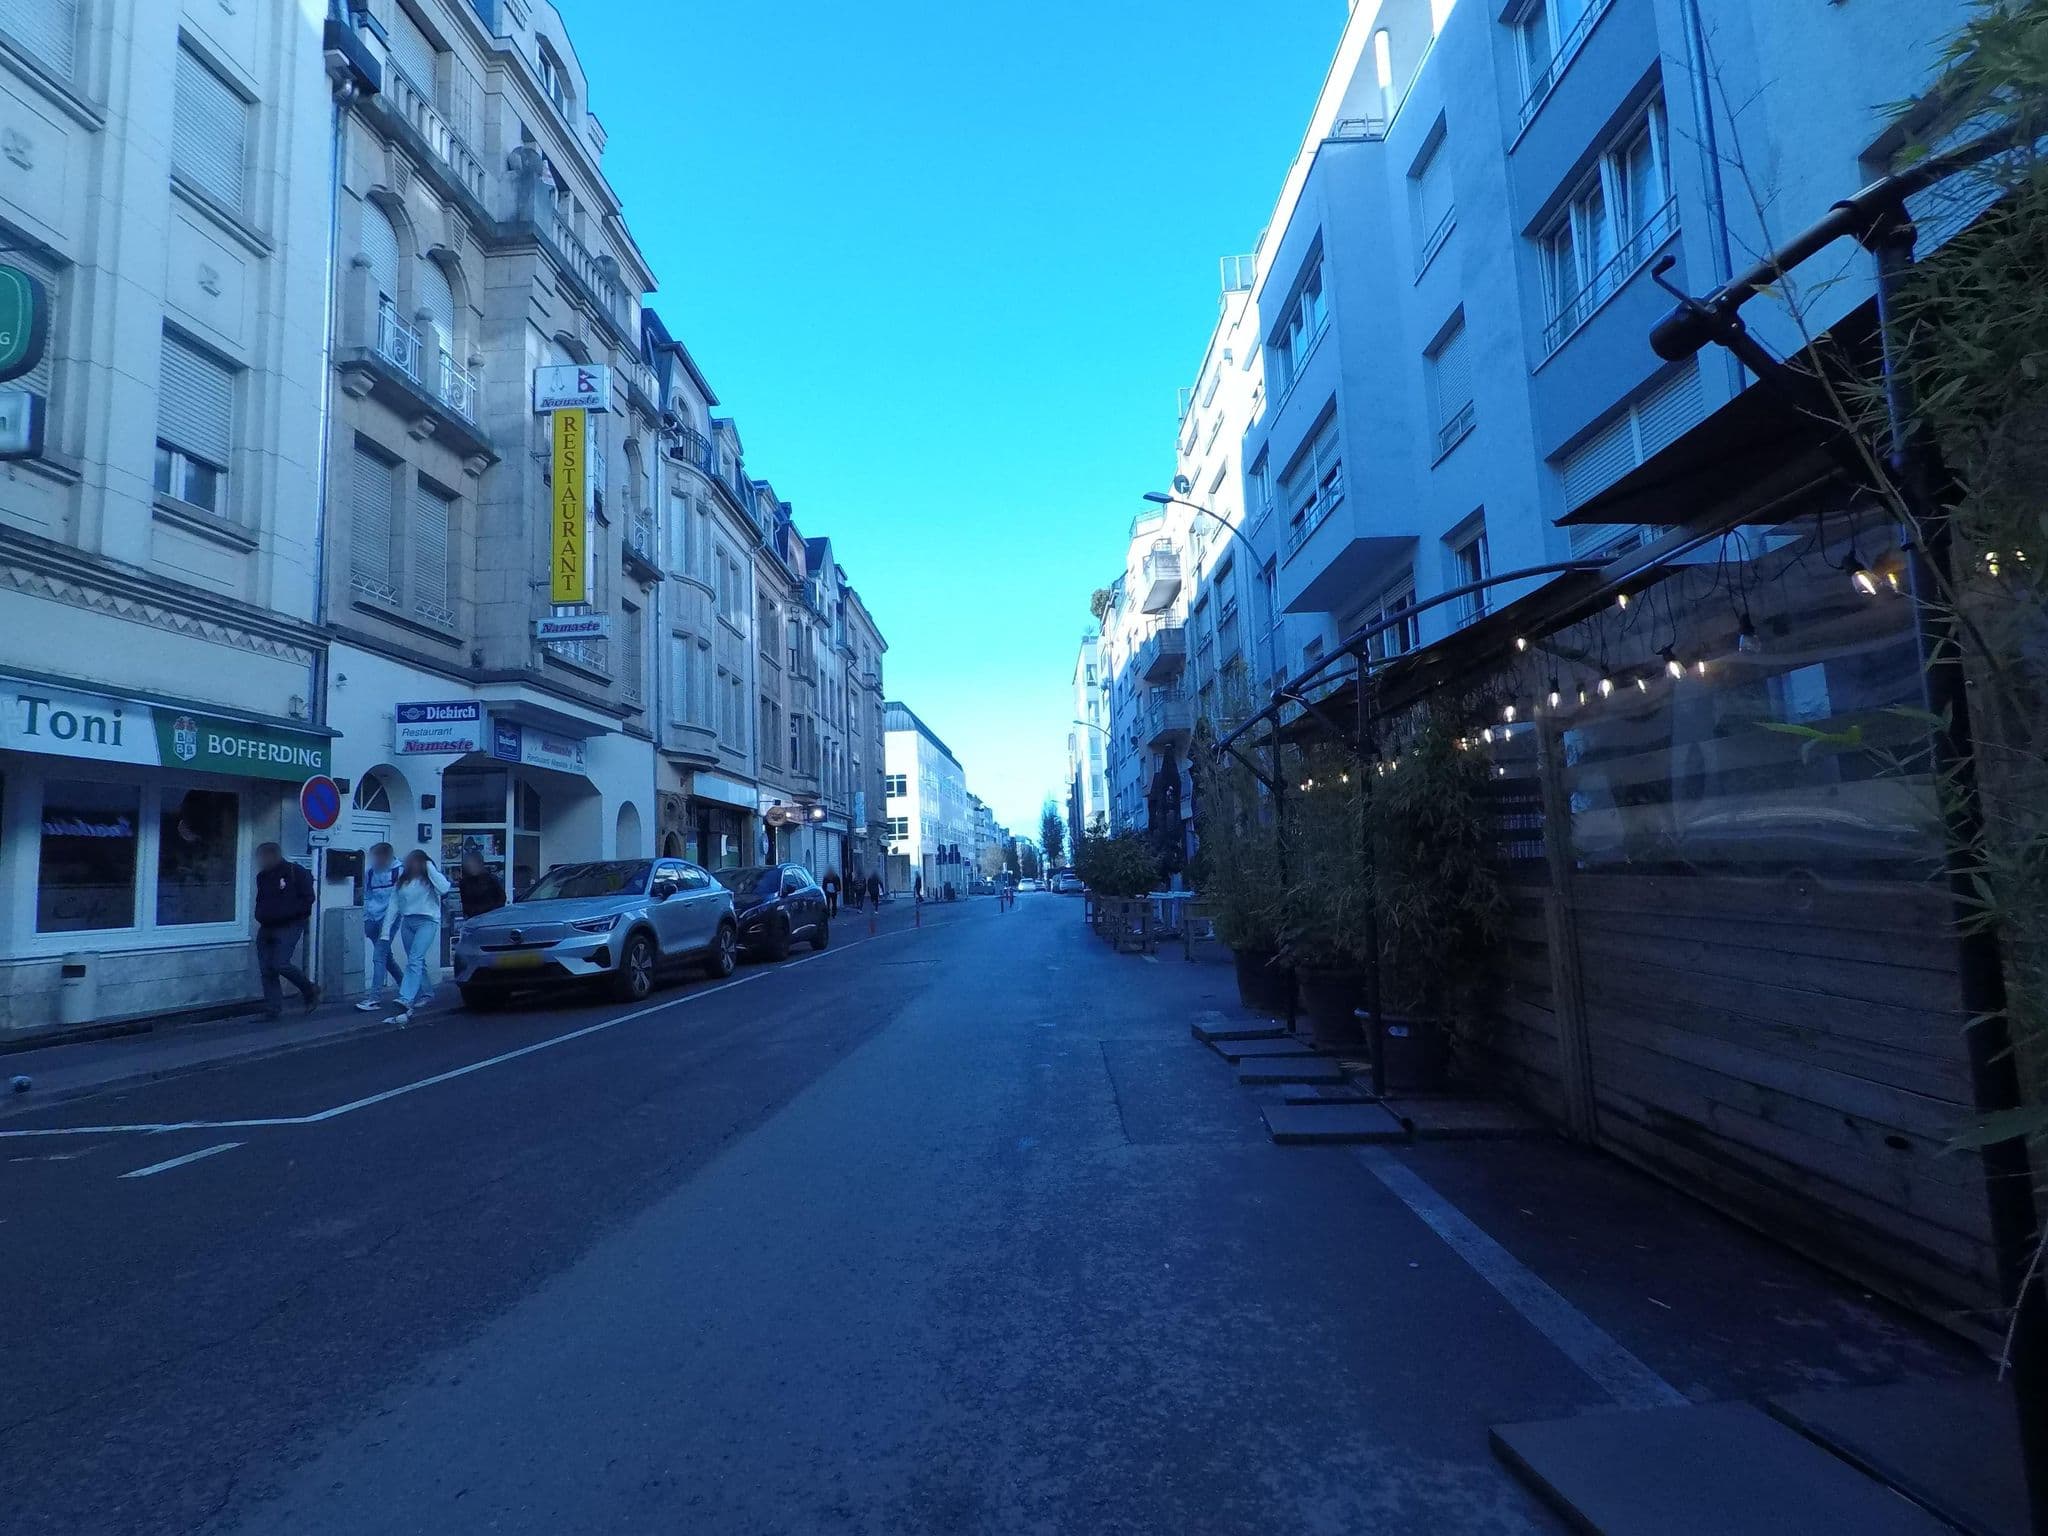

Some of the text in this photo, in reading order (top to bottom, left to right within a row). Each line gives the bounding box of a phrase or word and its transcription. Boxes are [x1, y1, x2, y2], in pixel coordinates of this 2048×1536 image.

[541, 395, 599, 407] Namaste
[560, 416, 577, 591] RESTAURANT
[541, 621, 600, 633] Namaste
[426, 706, 476, 719] Diekirch
[16, 695, 122, 746] Toni
[402, 727, 452, 737] Restaurant
[208, 734, 322, 768] BOFFERDING
[402, 738, 474, 752] Namaste
